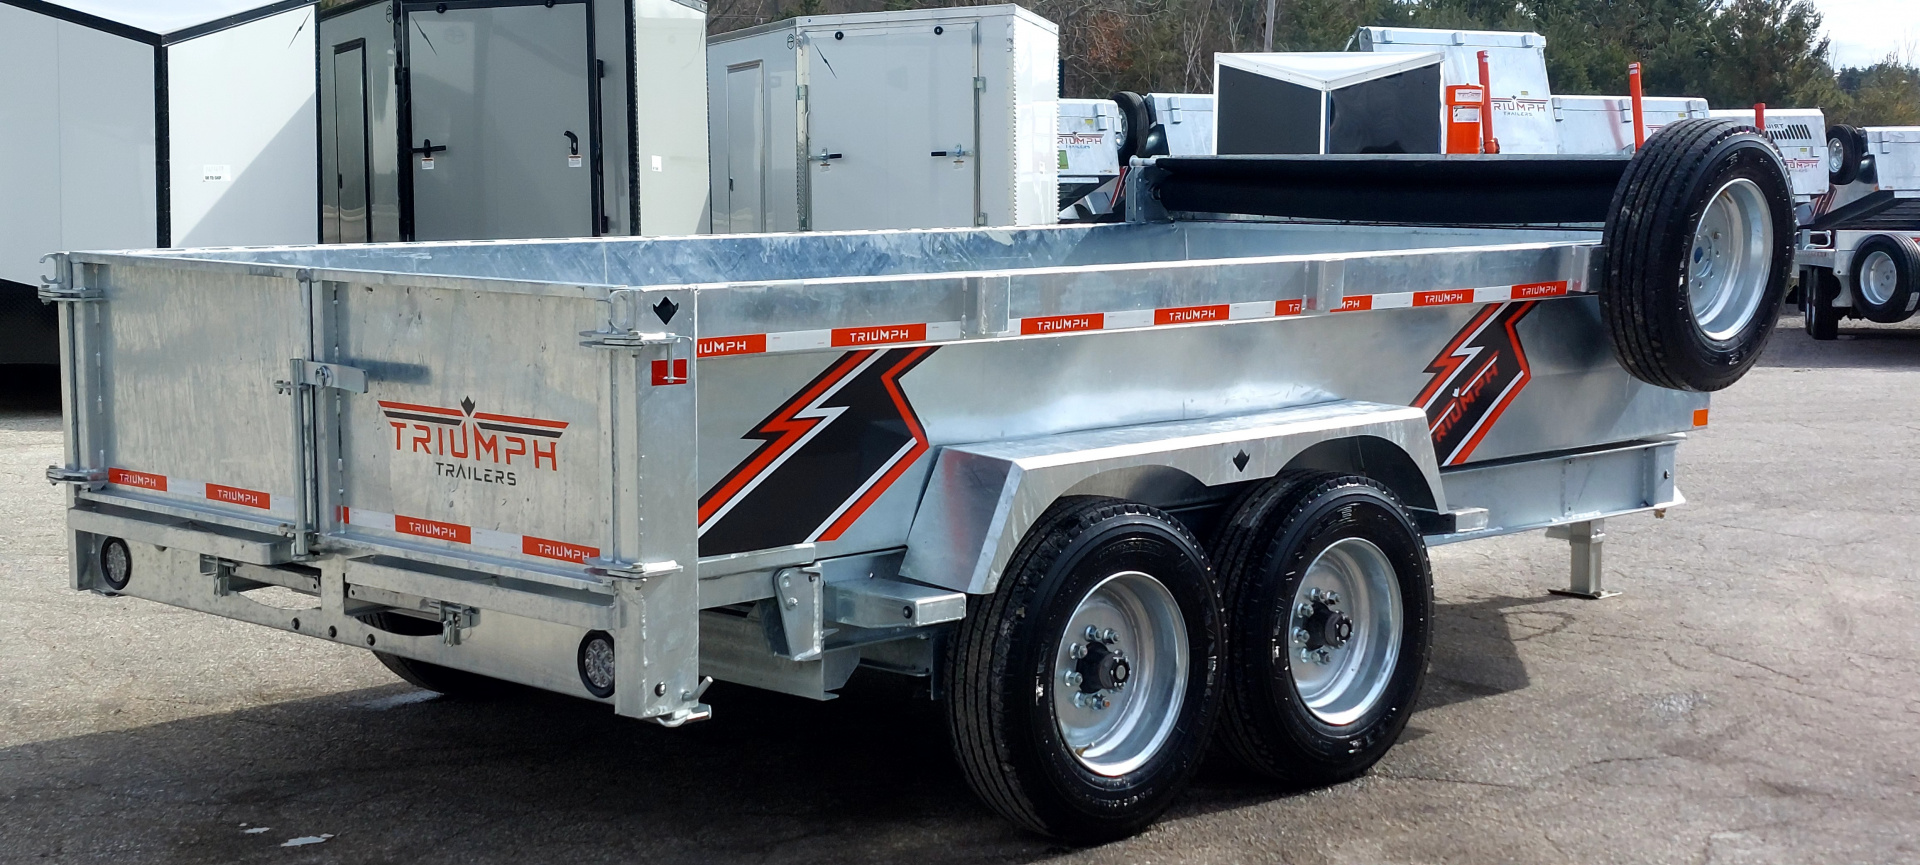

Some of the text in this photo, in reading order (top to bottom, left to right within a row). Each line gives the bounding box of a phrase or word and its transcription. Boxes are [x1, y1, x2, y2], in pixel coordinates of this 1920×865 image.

[1494, 102, 1546, 112] RIUMPH
[1057, 137, 1102, 145] RIUMPH
[1424, 292, 1464, 304] TRIUMPH
[1521, 285, 1557, 297] TRIUMPH
[1168, 308, 1216, 321] TRIUMPH
[1037, 318, 1089, 331] TRIUMPH
[850, 329, 909, 343] TRIUMPH
[699, 340, 747, 354] IUMPH
[1436, 362, 1499, 442] RIUMPH
[389, 420, 558, 472] TRIUMPH
[119, 473, 156, 487] TRIUMPH
[435, 461, 517, 486] TRAILERS
[217, 489, 258, 505] TRIUMPH
[408, 521, 457, 539] TRIUMPH
[537, 542, 590, 562] TRIUMPH
